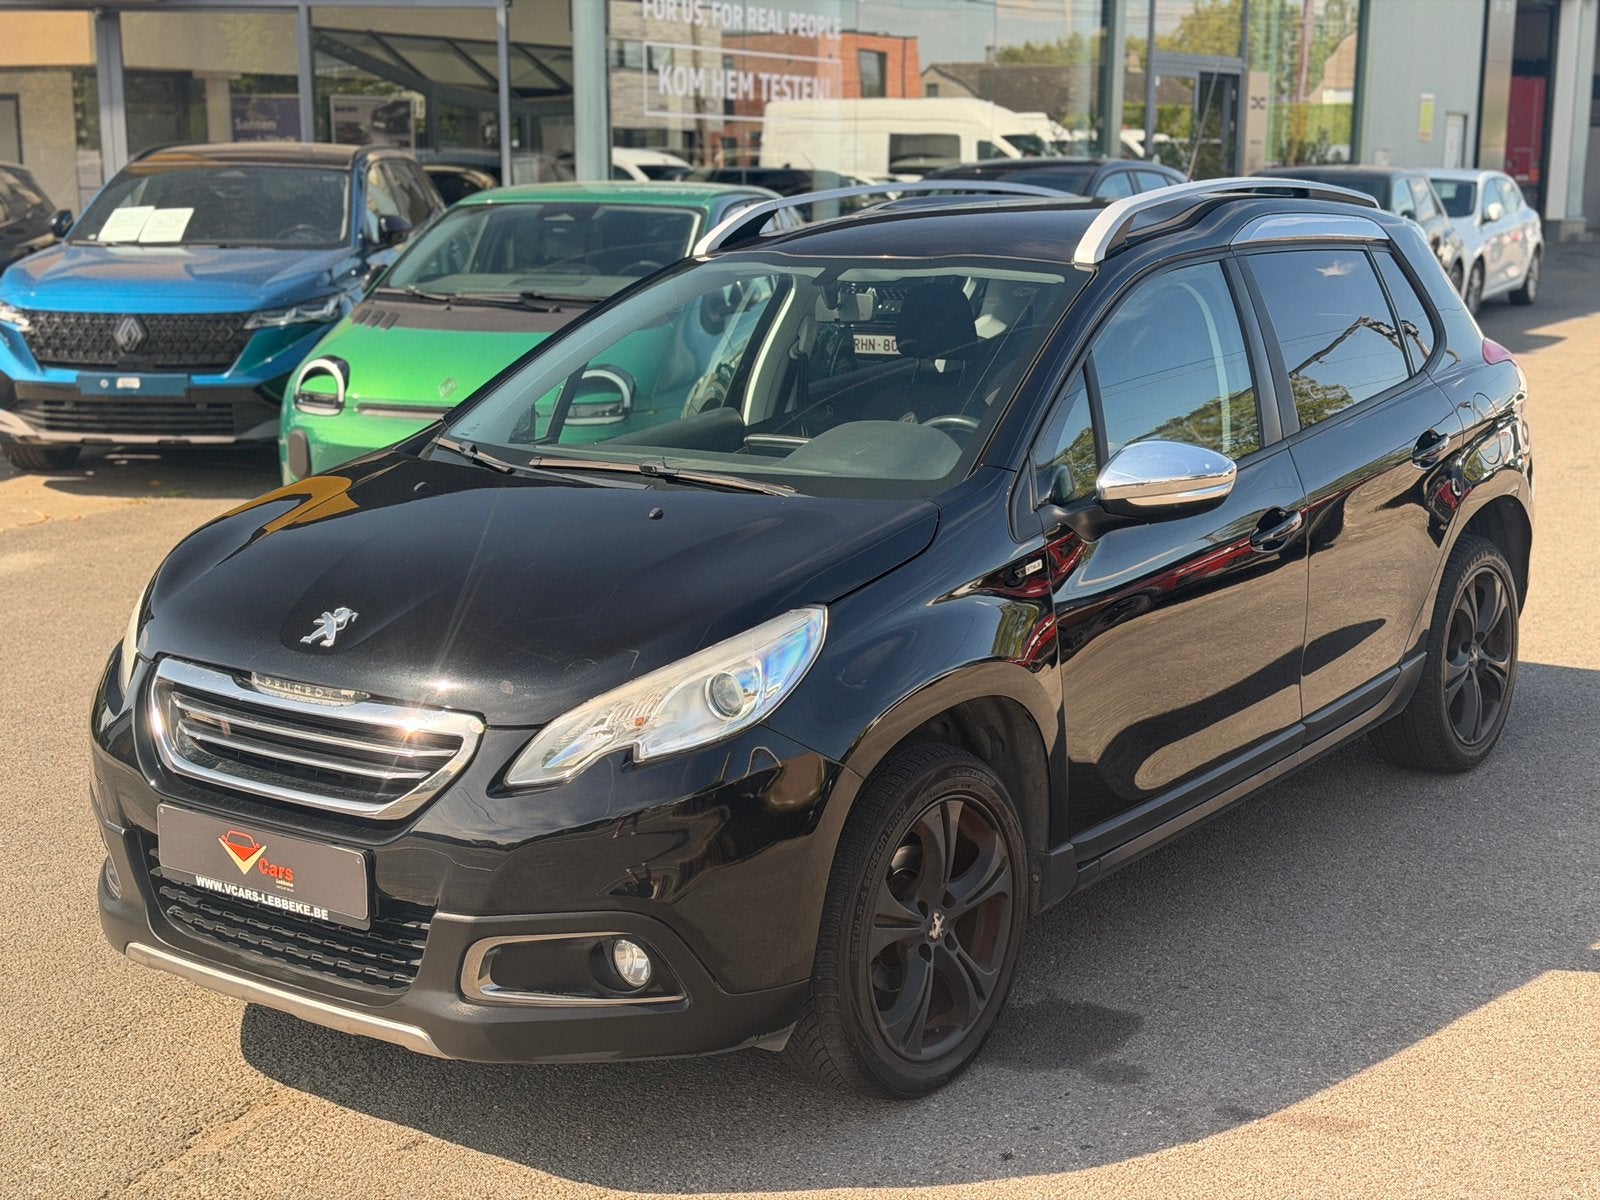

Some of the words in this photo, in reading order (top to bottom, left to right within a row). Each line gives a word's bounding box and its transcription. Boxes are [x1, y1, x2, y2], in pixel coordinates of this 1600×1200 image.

[643, 0, 678, 21] FOR
[712, 1, 744, 30] FOR
[748, 8, 785, 34] REAL
[788, 12, 842, 40] PEOPLE
[657, 64, 705, 97] KOM
[711, 69, 755, 100] HEM
[258, 857, 295, 881] Cars
[195, 875, 330, 921] WWW.VCARS-LEBBEKE.BE
